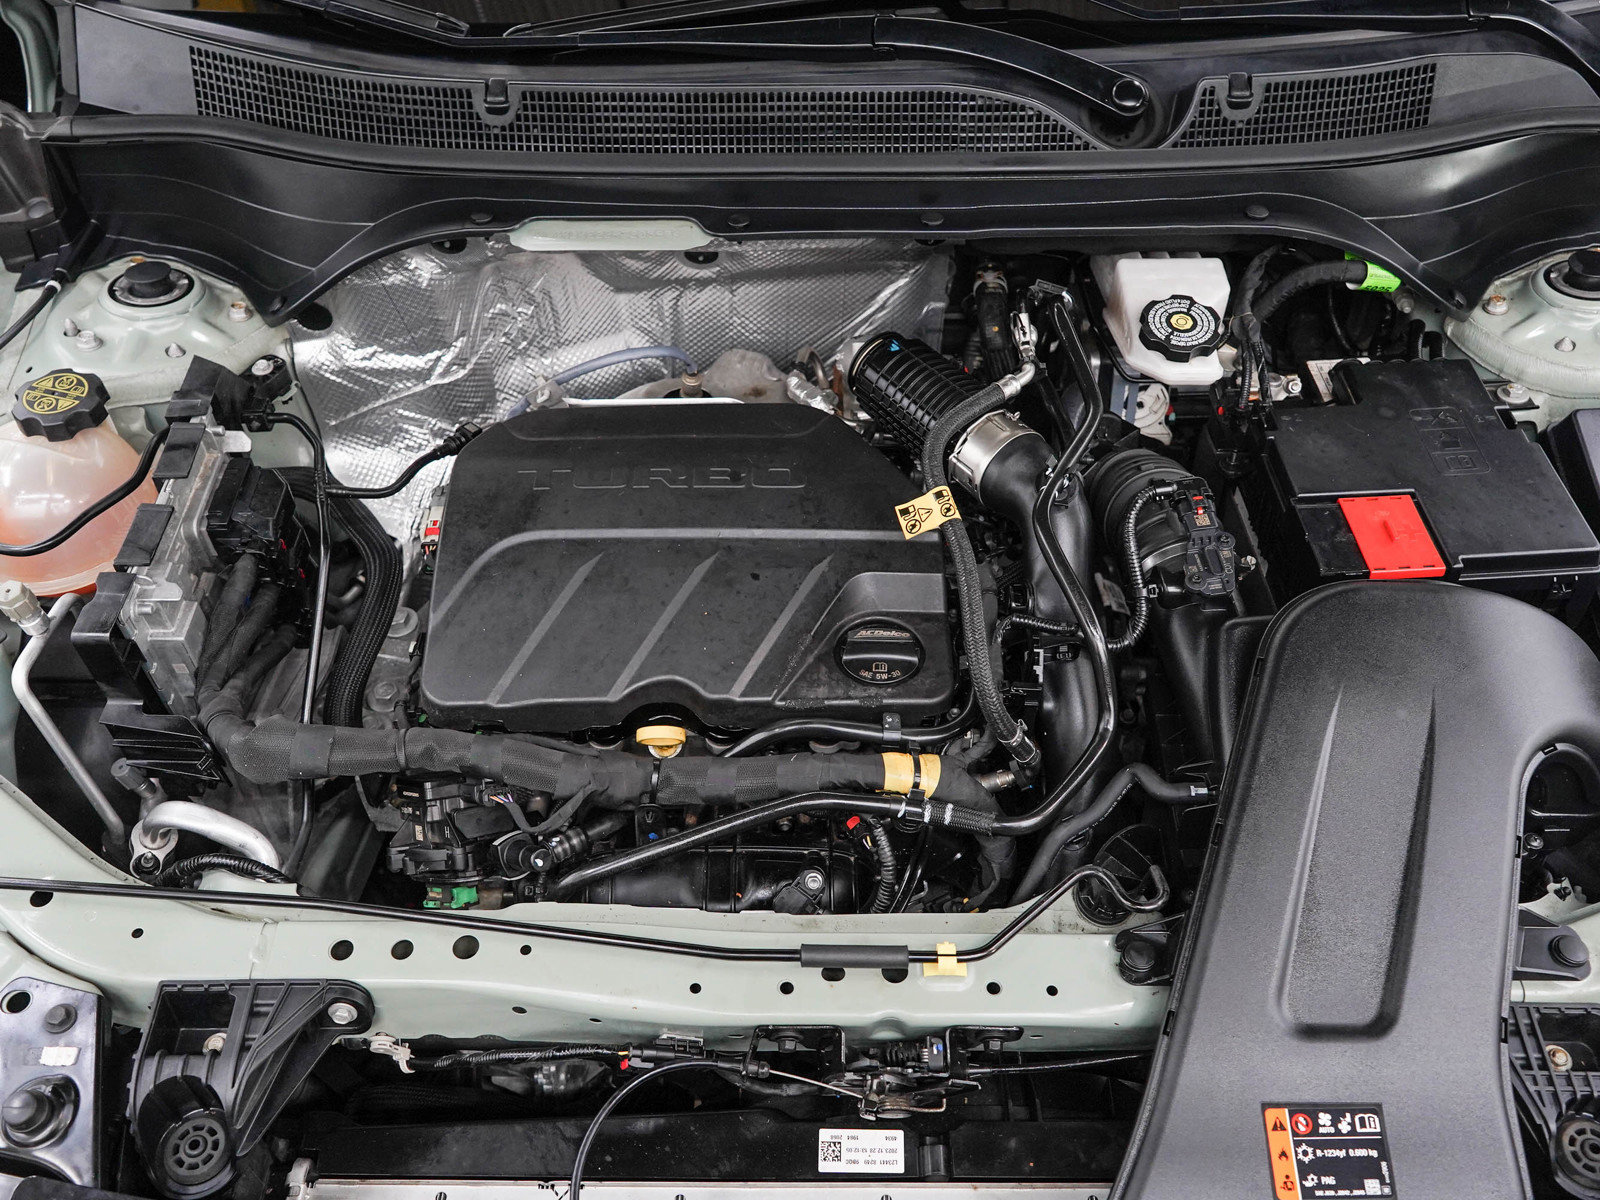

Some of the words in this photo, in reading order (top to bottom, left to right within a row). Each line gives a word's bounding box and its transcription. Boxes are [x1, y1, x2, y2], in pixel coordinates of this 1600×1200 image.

[517, 468, 806, 490] TURBO
[859, 670, 873, 678] SAE
[876, 670, 901, 680] 5W-30
[1316, 1149, 1346, 1158] R-1234yf
[1368, 1149, 1378, 1158] kg
[1321, 1176, 1336, 1185] PAG
